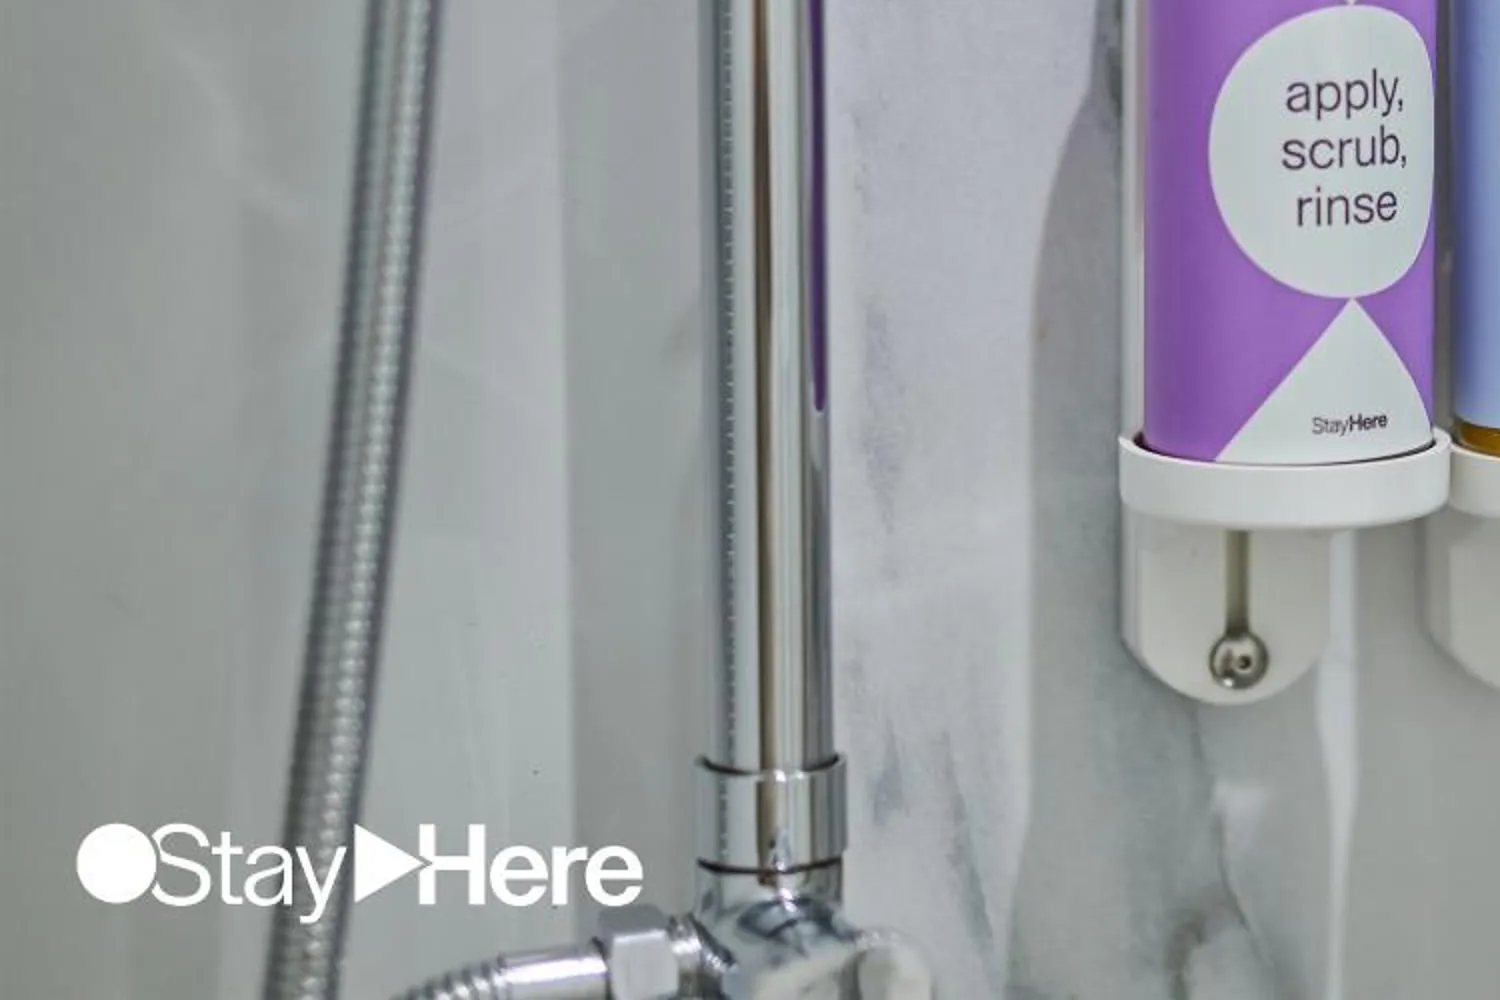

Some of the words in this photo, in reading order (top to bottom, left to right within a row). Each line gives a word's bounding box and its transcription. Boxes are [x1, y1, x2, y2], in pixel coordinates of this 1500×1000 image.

[1286, 67, 1403, 121] apply,
[1281, 124, 1407, 171] scrub,
[1297, 185, 1398, 227] rinse
[1311, 412, 1388, 437] StayHere
